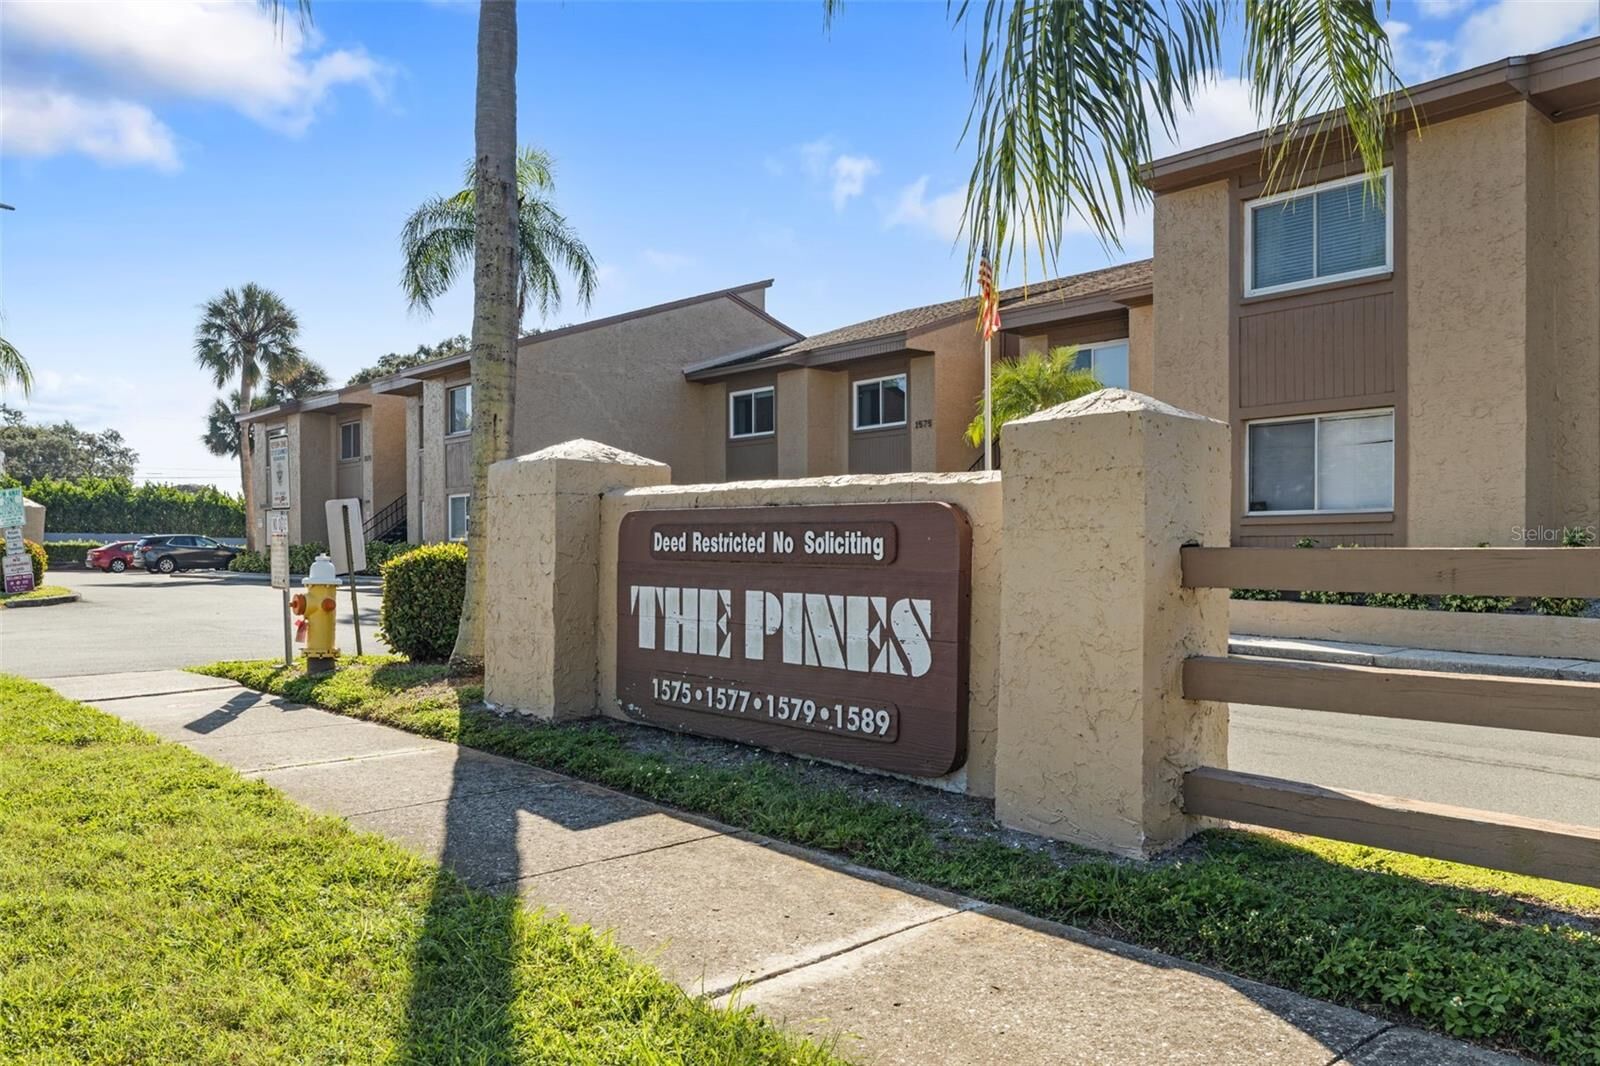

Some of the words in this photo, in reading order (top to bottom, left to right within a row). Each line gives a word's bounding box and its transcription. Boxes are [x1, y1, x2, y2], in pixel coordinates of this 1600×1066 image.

[654, 532, 686, 552] Deed
[692, 532, 765, 553] Restricted
[773, 531, 794, 553] No
[804, 531, 884, 560] Soliciting
[631, 586, 731, 659] THE
[745, 590, 931, 678] PINES
